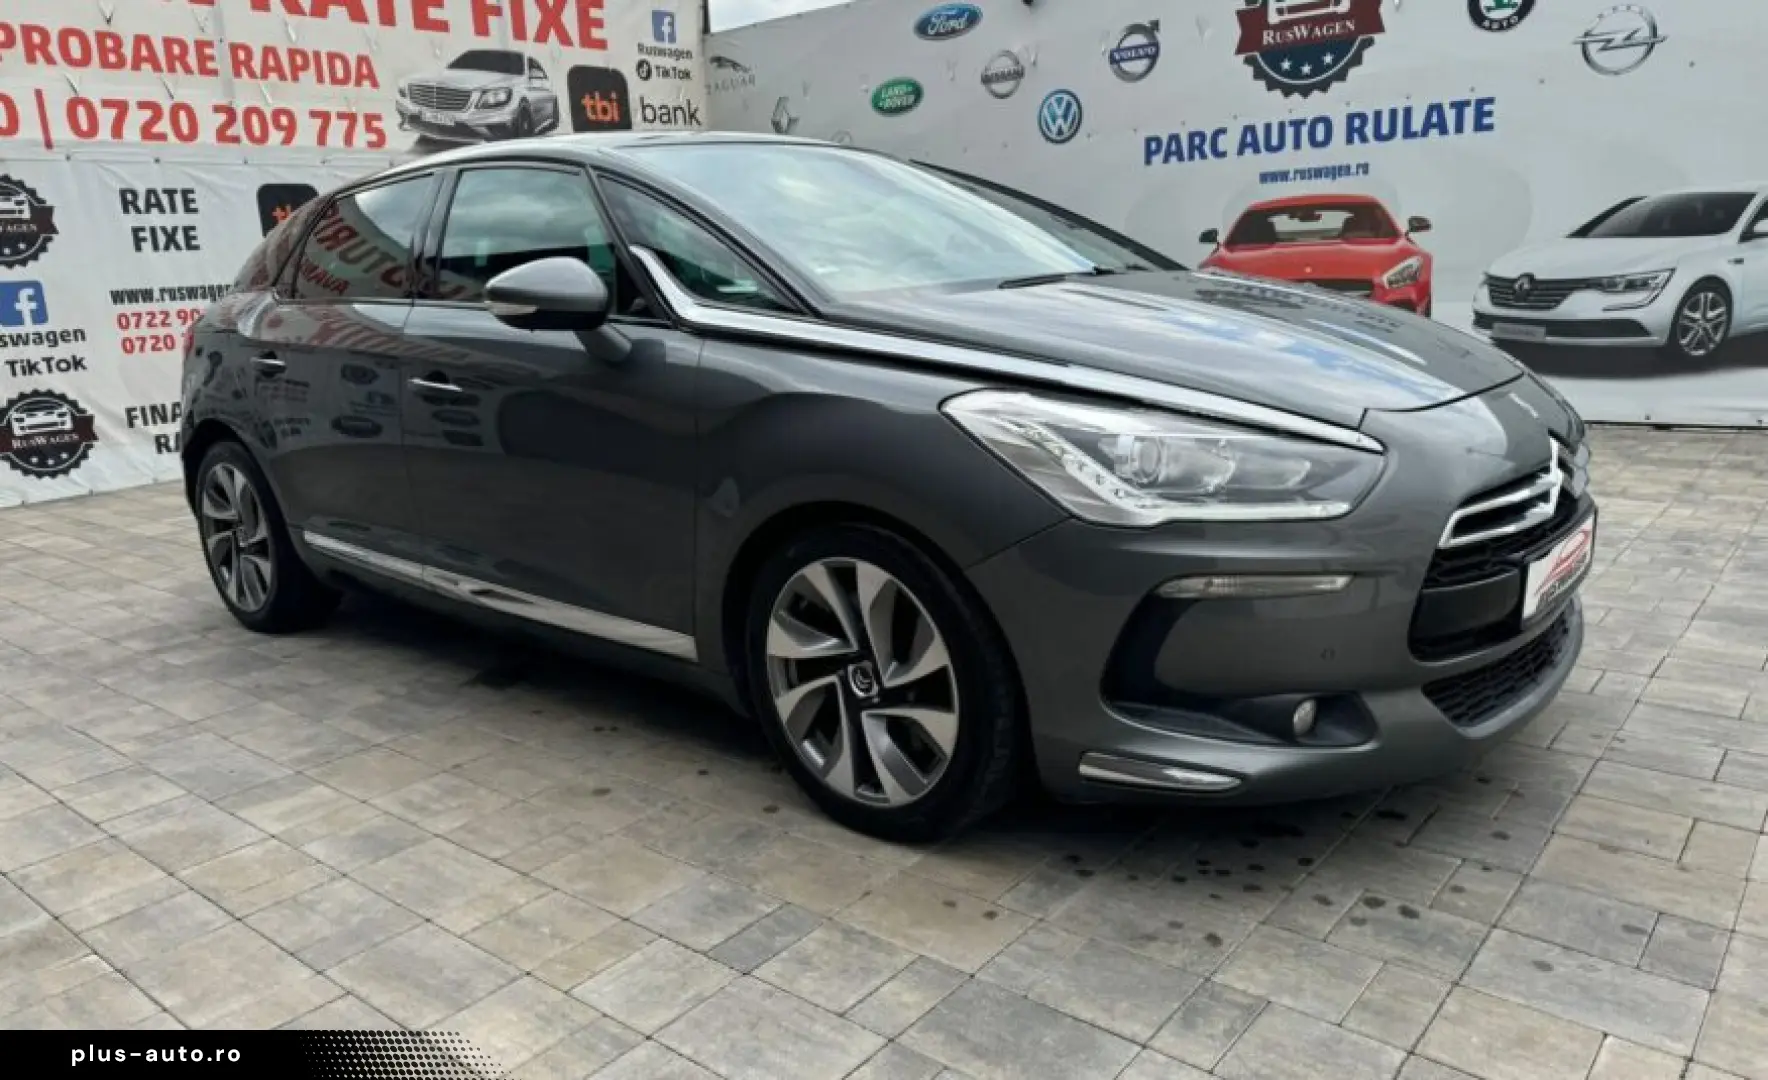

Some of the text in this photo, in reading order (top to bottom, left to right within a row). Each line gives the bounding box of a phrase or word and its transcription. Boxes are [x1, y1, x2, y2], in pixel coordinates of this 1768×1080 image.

[471, 0, 608, 51] FIXE
[927, 10, 970, 36] Ford
[229, 42, 380, 90] RAPIDA
[66, 96, 200, 143] 0720
[212, 104, 297, 146] 209
[309, 110, 387, 149] 775
[581, 91, 702, 126] tbi bank
[1144, 97, 1495, 166] PARC AUTO RULATE
[1259, 161, 1369, 184] www.ruswagen.ro
[119, 187, 199, 215] RATE
[130, 225, 201, 253] FIXE
[117, 310, 172, 331] 0722
[121, 334, 176, 354] 0720
[5, 354, 88, 378] TikTok
